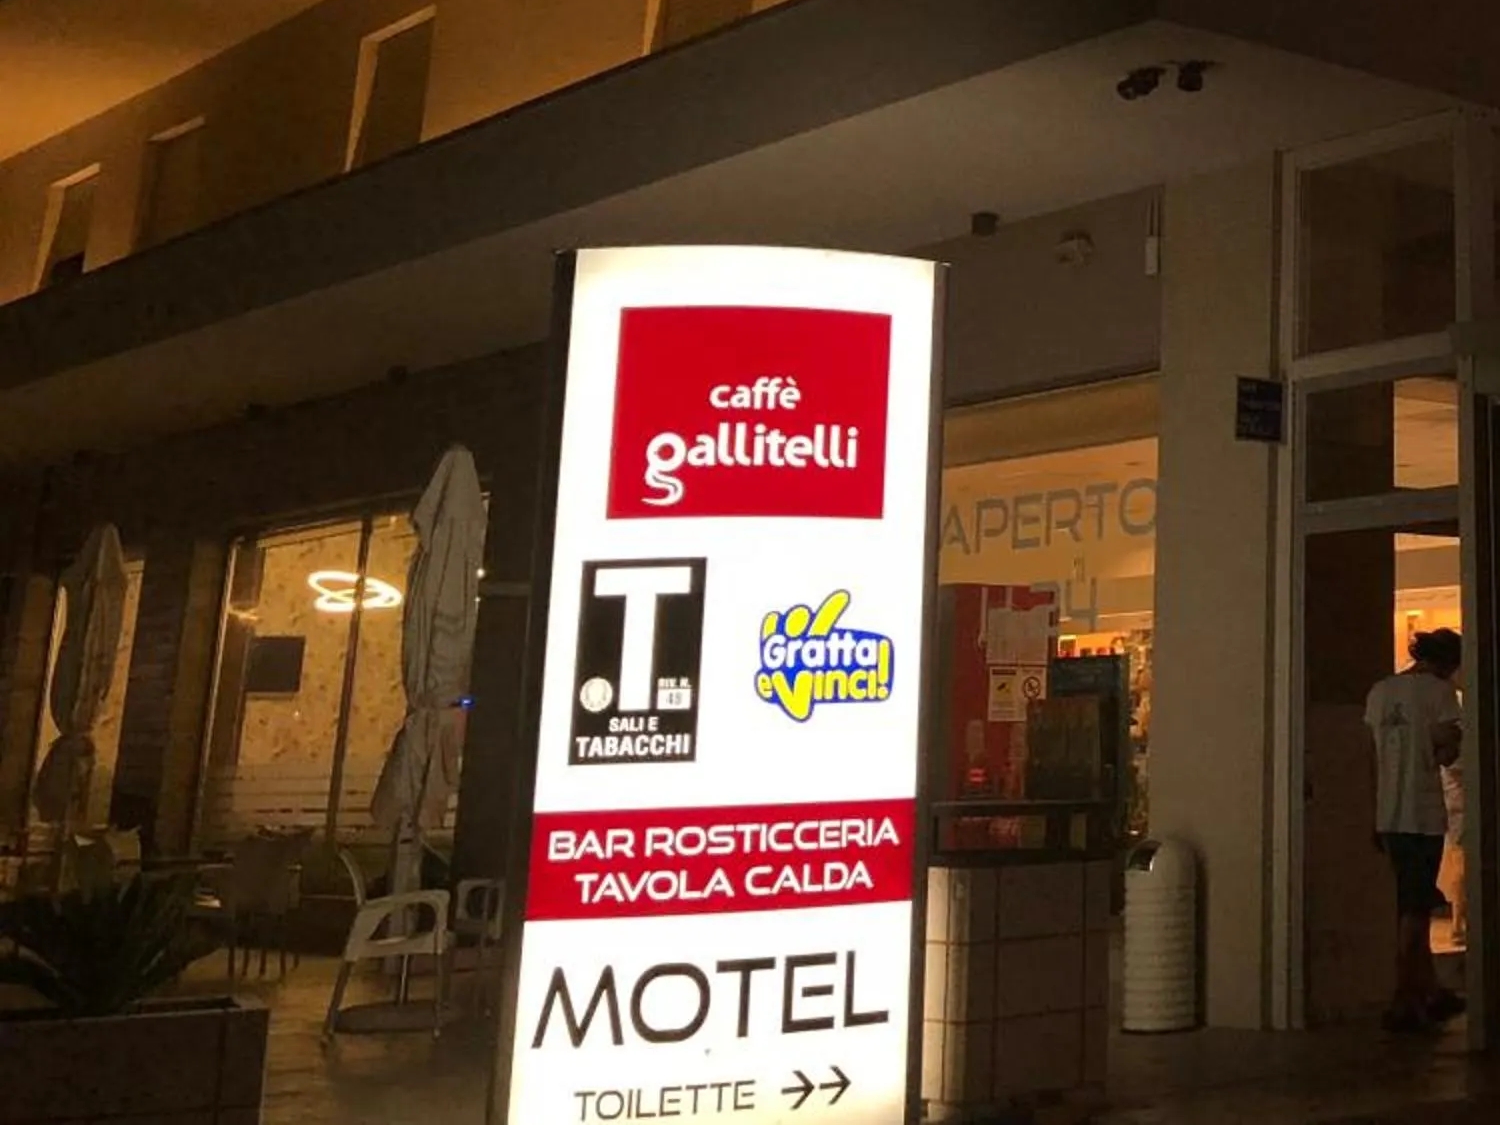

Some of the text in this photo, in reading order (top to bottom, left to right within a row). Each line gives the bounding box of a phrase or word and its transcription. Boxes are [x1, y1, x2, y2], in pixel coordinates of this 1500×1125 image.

[709, 376, 801, 409] caffè
[641, 422, 859, 506] gallitelli
[941, 477, 1157, 556] APERTO
[763, 632, 877, 669] Gratta
[757, 674, 772, 698] e
[576, 733, 691, 757] TABACCHI
[609, 716, 659, 732] SALI E
[548, 817, 900, 861] BAR ROSTICCERIA
[575, 860, 874, 904] TAVOLA CALDA
[531, 950, 889, 1049] MOTEL
[574, 1079, 756, 1122] TOILETTE
